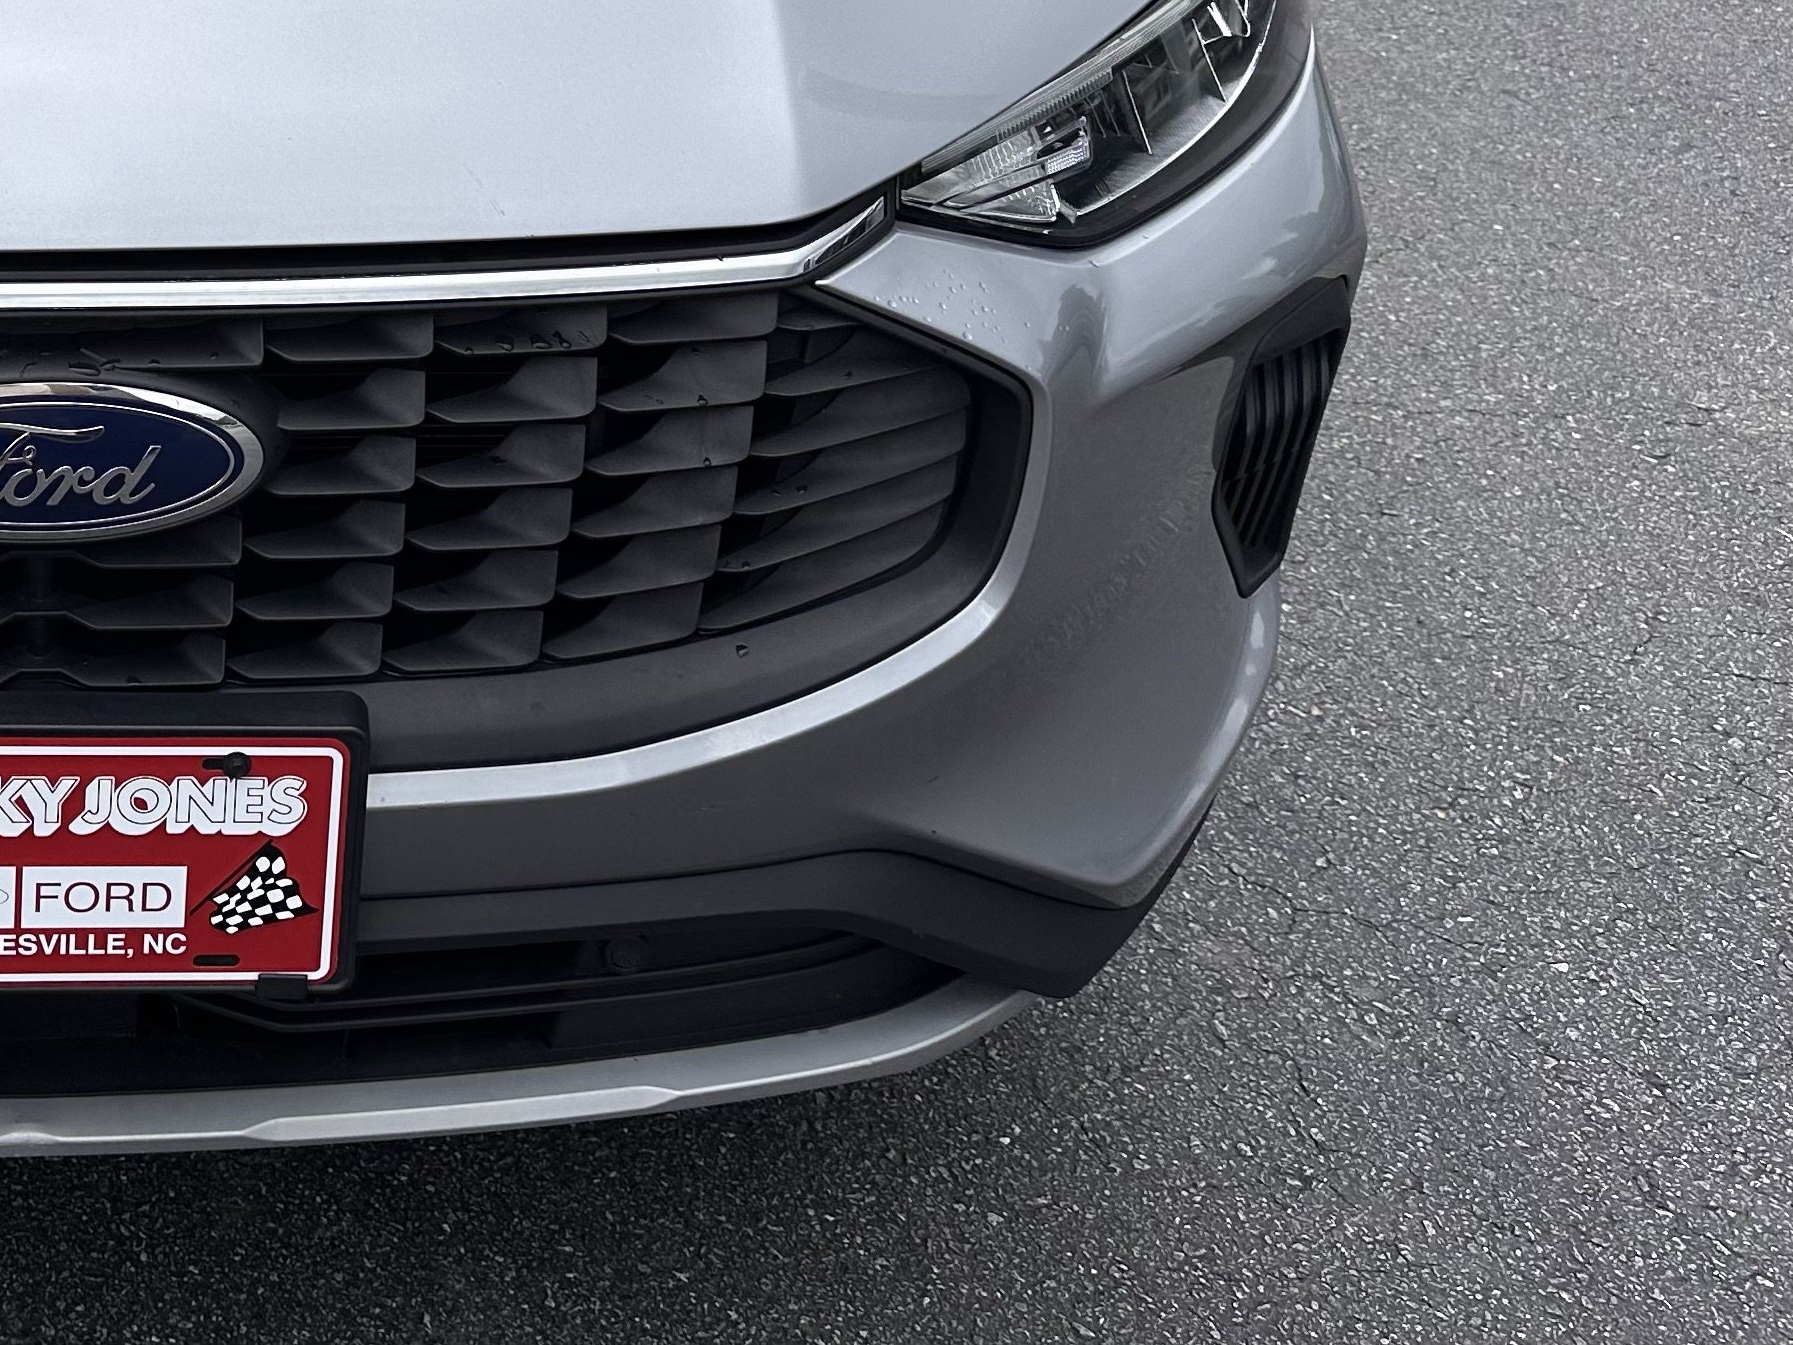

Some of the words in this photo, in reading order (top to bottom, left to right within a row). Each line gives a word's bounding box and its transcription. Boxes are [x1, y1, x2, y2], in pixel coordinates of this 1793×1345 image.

[69, 775, 308, 837] JONES
[34, 881, 173, 913] FORD
[143, 932, 188, 956] NC
